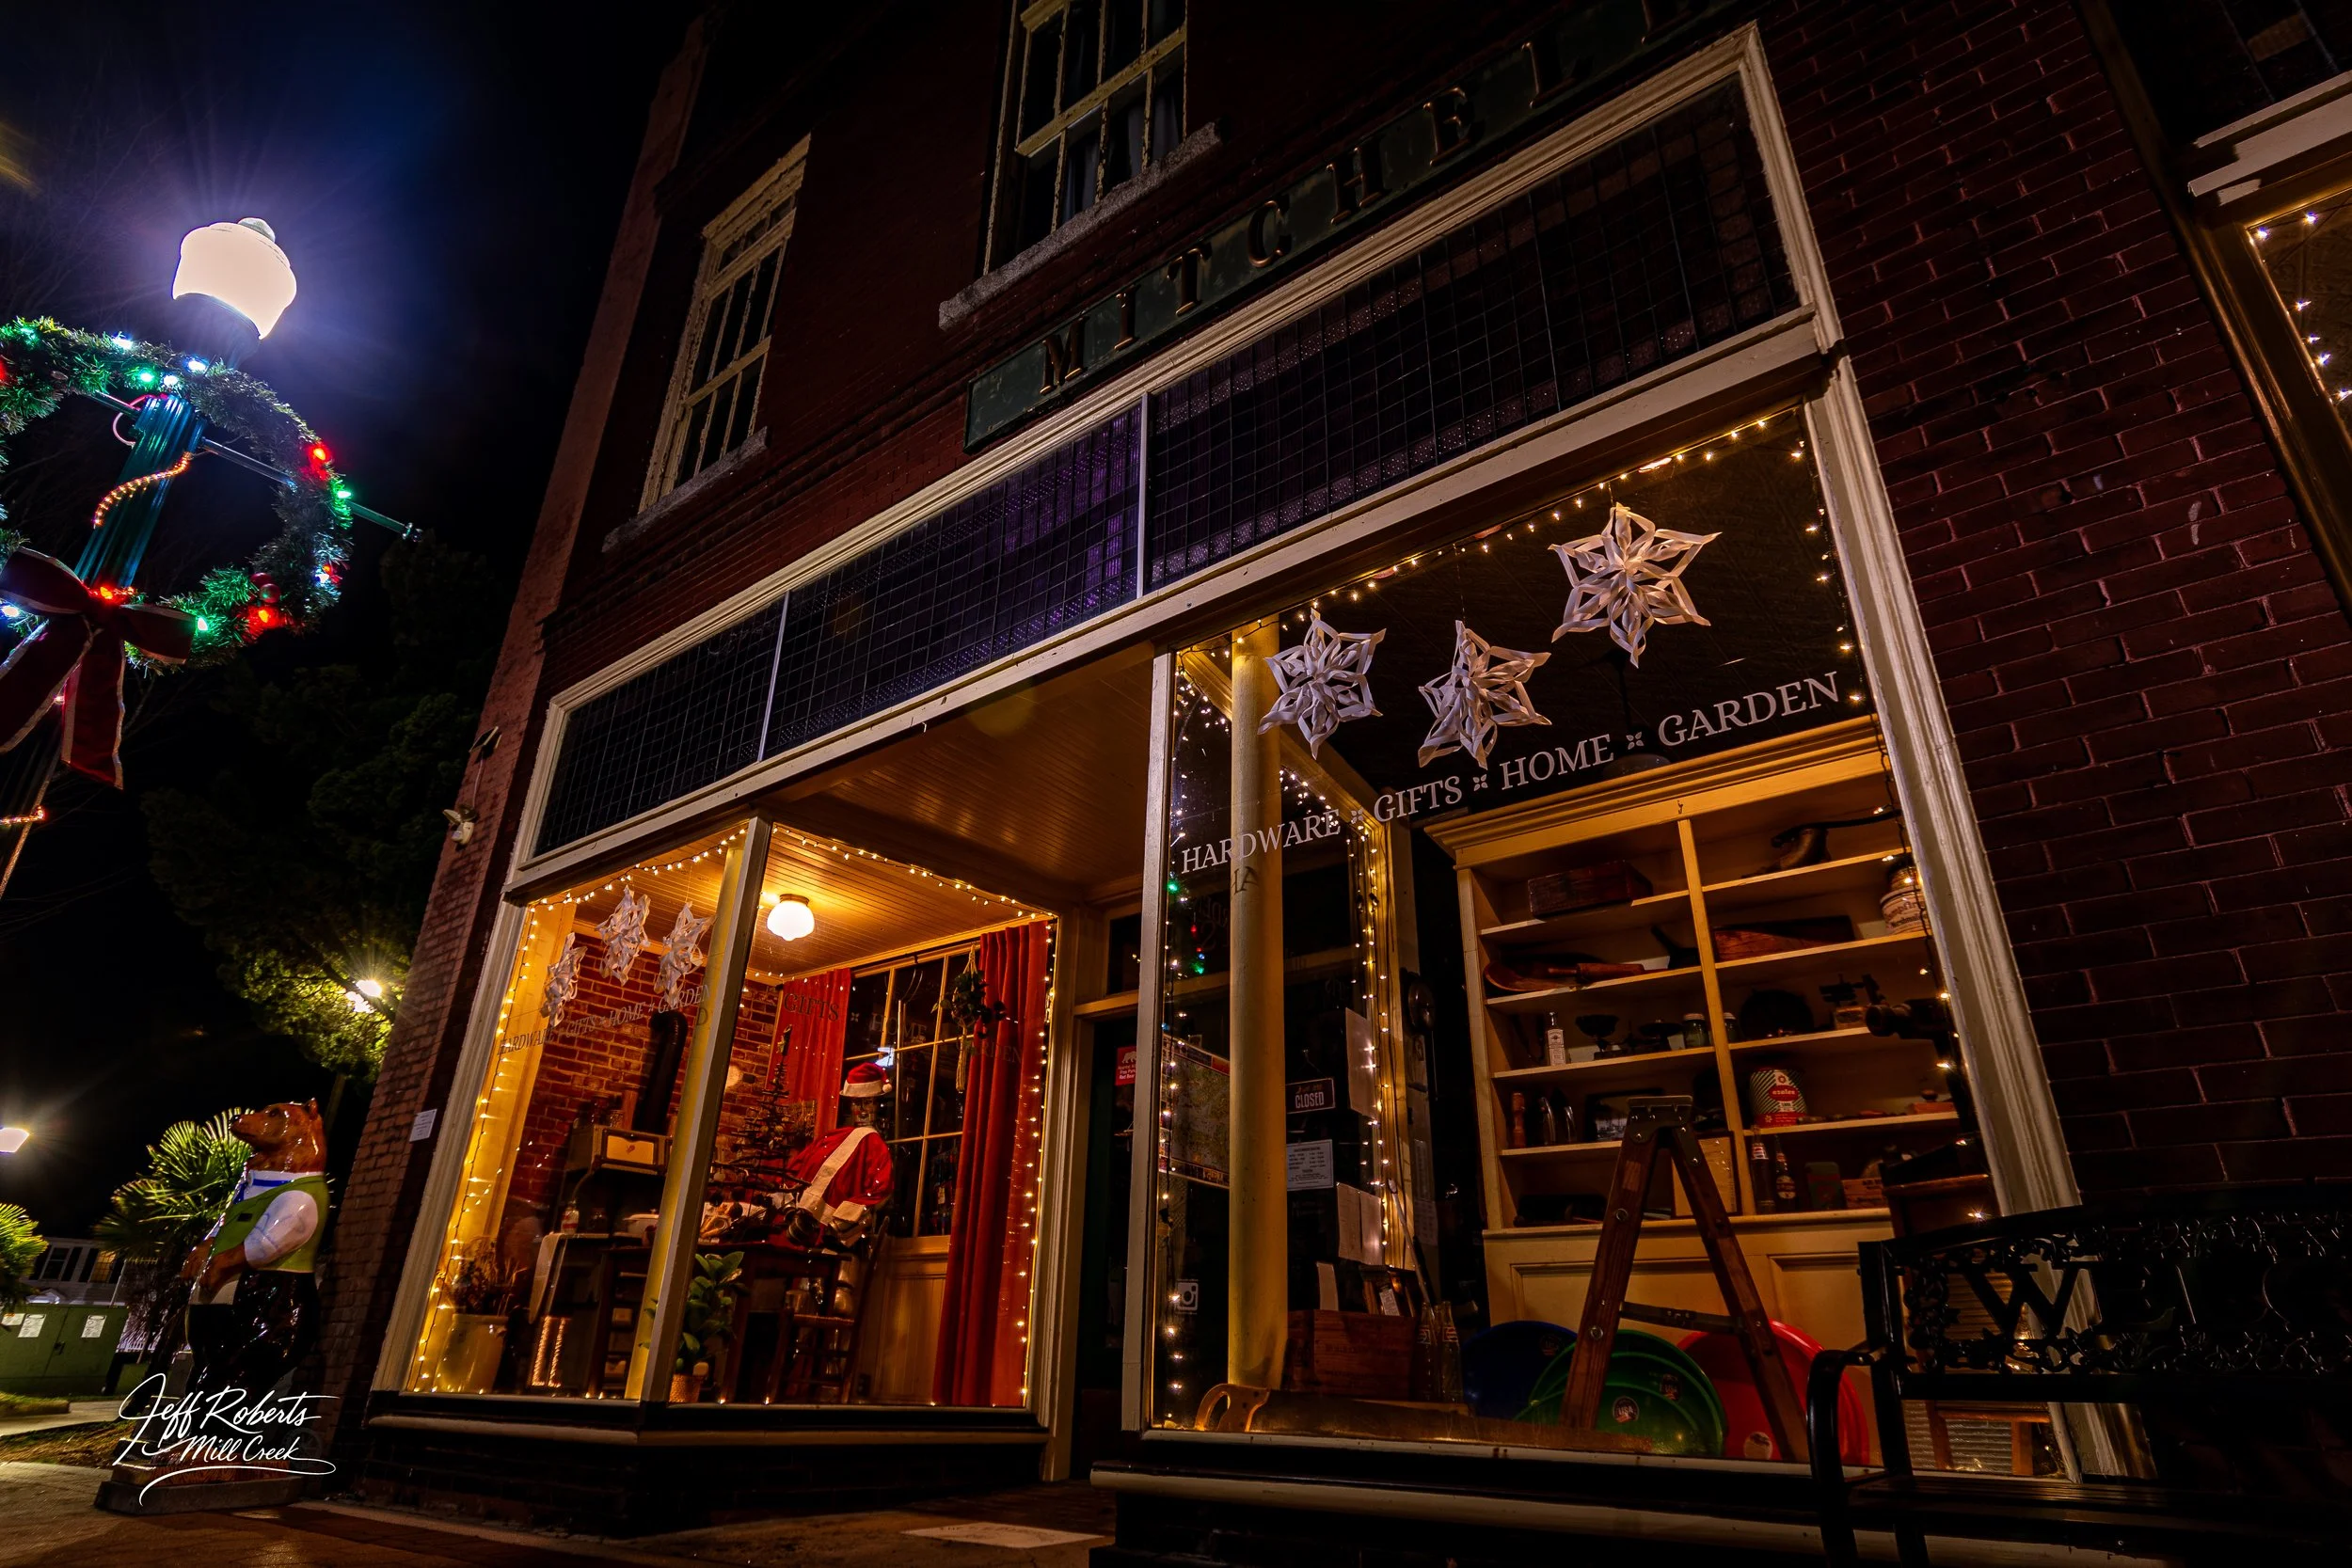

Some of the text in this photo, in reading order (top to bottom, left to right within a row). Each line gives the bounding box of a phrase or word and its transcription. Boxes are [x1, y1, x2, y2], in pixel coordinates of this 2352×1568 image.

[1182, 672, 1840, 874] HARDWARE GIFTS HOME GARDEN
[609, 1002, 646, 1026] HOME
[784, 992, 839, 1022] GIFTS
[1295, 1091, 1325, 1109] CLOSED
